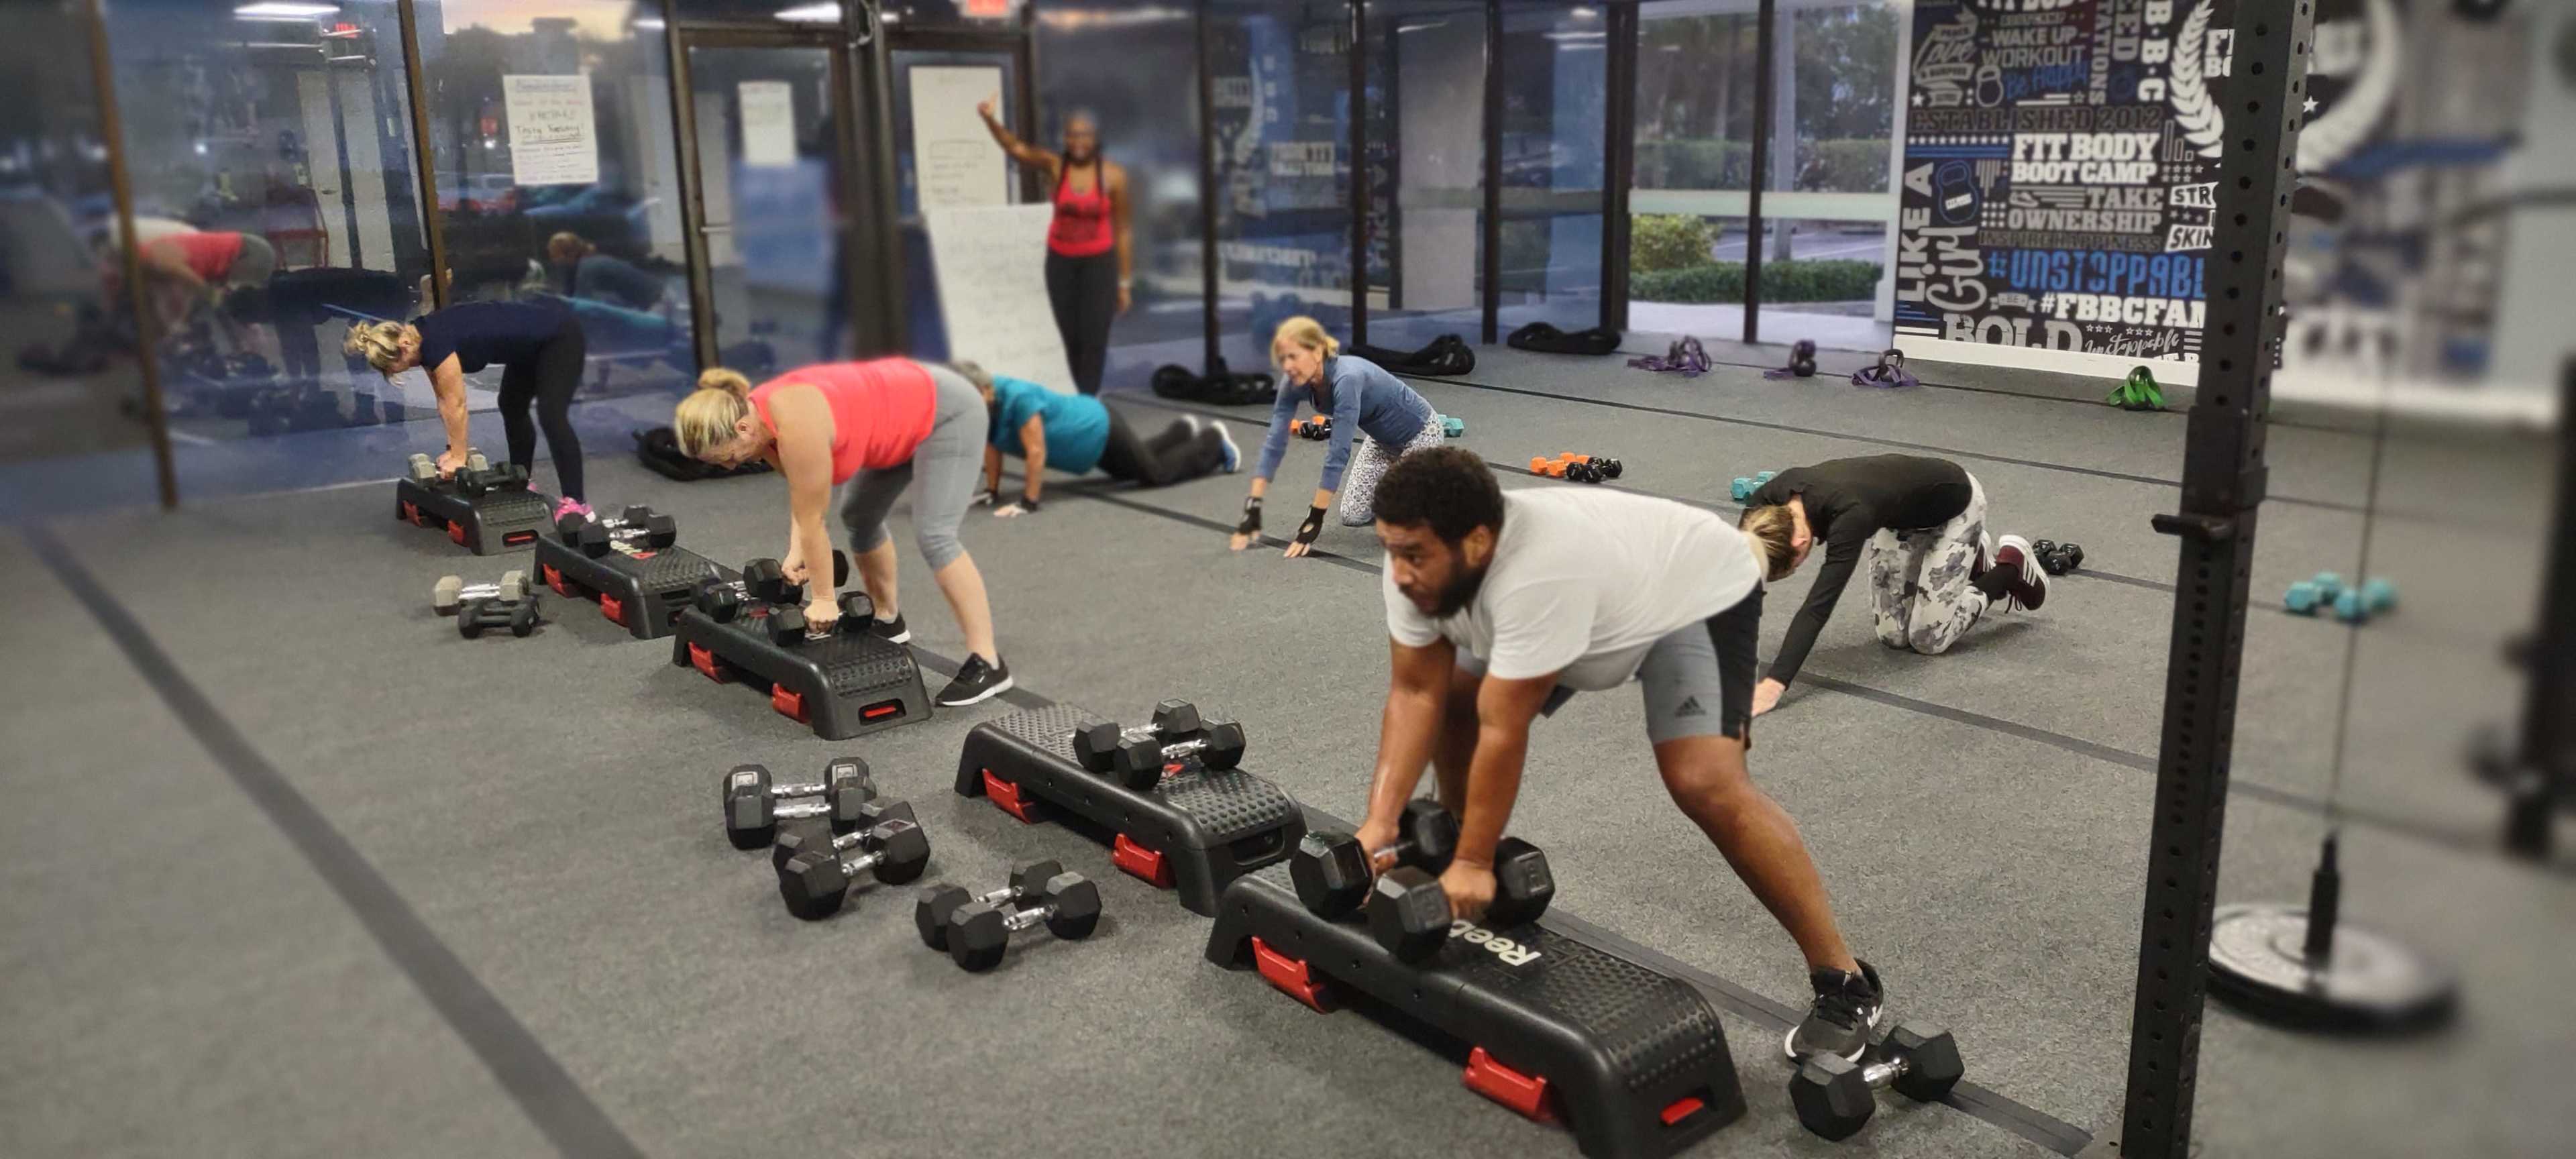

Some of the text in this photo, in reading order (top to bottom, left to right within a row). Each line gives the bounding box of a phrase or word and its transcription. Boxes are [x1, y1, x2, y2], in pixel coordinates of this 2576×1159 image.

[1992, 25, 2078, 46] WAKE UP
[1981, 46, 2085, 68] WORKOUT
[2006, 62, 2089, 99] Be Happy
[1909, 105, 2163, 133] ESTABLISHED 2012
[2012, 132, 2160, 161] FIT BODY
[2011, 161, 2157, 184] BOOT CAMP
[2084, 186, 2164, 211] TAKE
[2175, 186, 2216, 205] STR
[1898, 162, 1934, 302] LIKE A
[2007, 209, 2162, 234] OWNERSHIP
[2170, 227, 2213, 248] SKIN
[1919, 226, 1988, 311] Girl
[1987, 250, 2206, 298] #UNSTOPPABL
[1943, 312, 2083, 353] BOLD
[1448, 918, 1543, 966] Reeb
